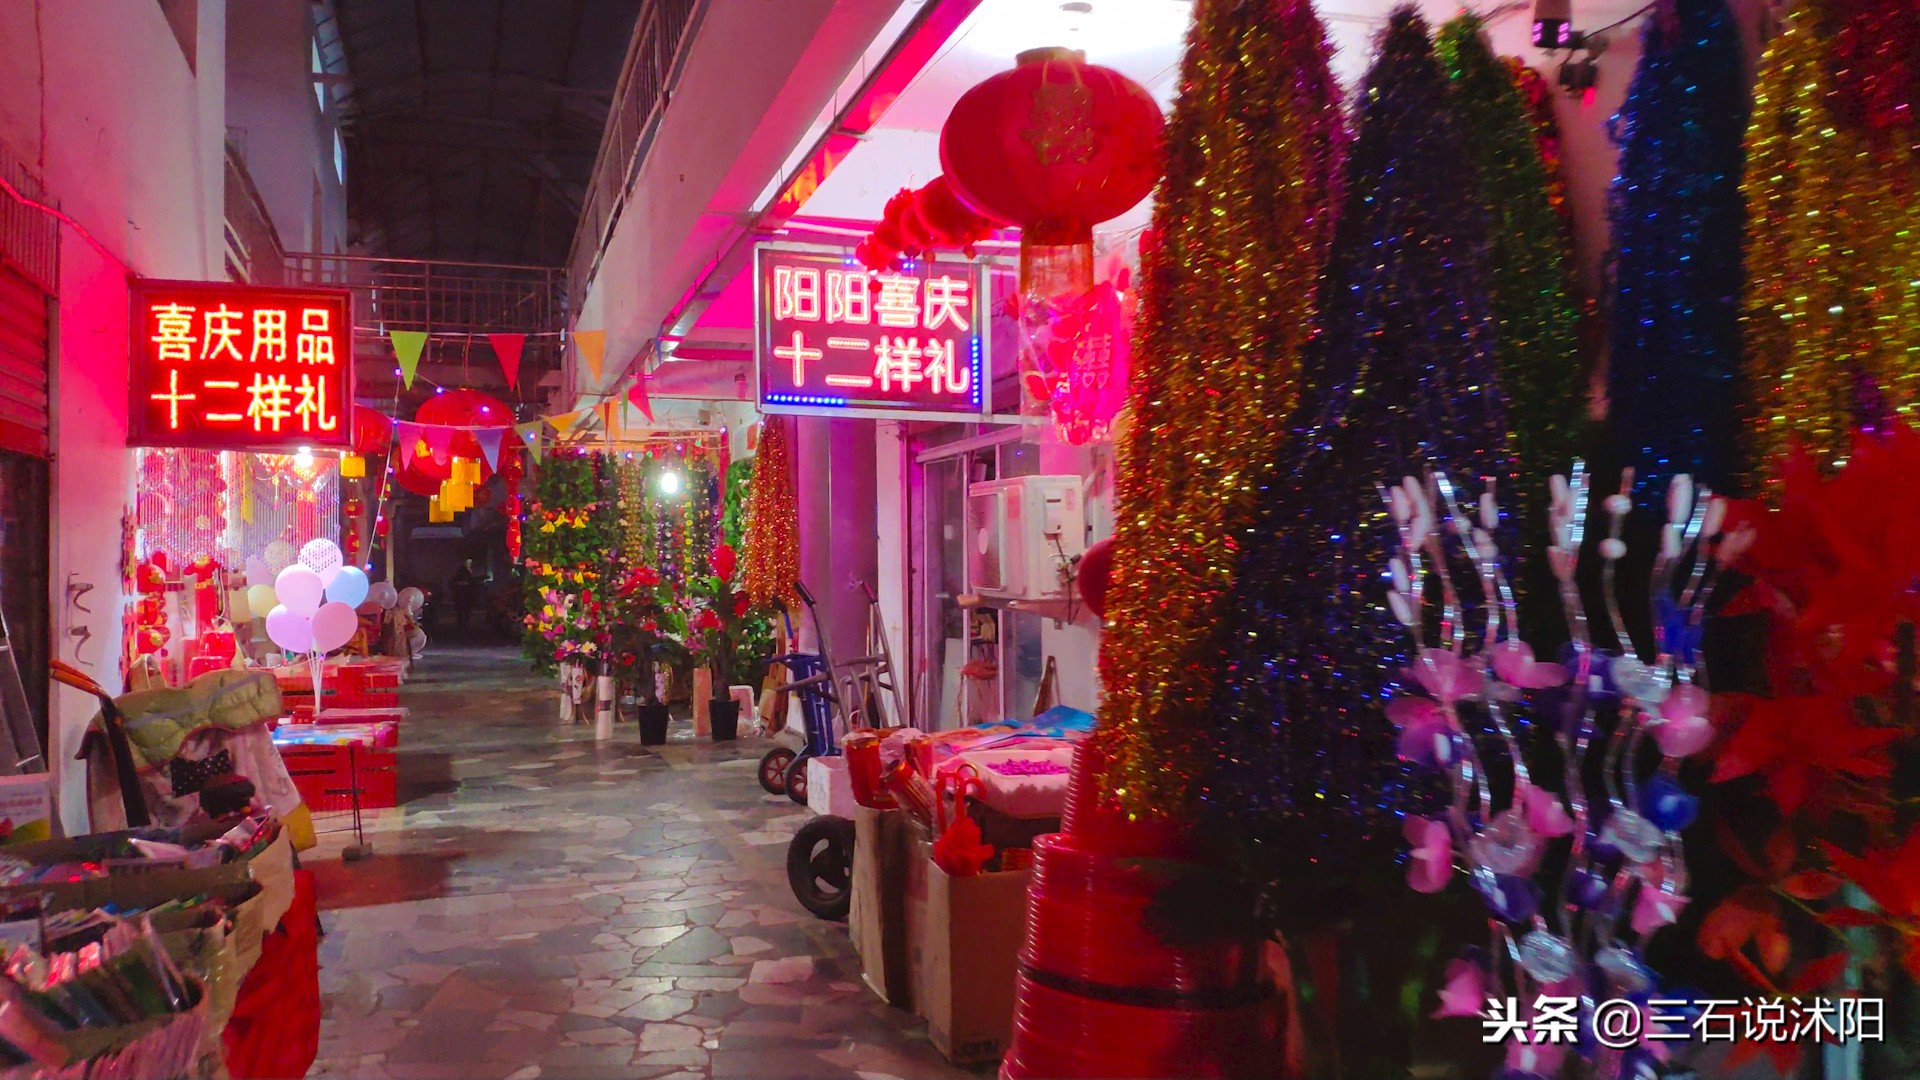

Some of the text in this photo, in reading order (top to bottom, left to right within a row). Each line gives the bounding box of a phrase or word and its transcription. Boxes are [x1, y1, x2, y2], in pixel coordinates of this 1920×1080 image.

[774, 265, 969, 331] 阳阳喜庆
[151, 302, 335, 365] 喜庆用品
[774, 330, 970, 394] 十二样礼
[151, 369, 336, 432] 十二样礼
